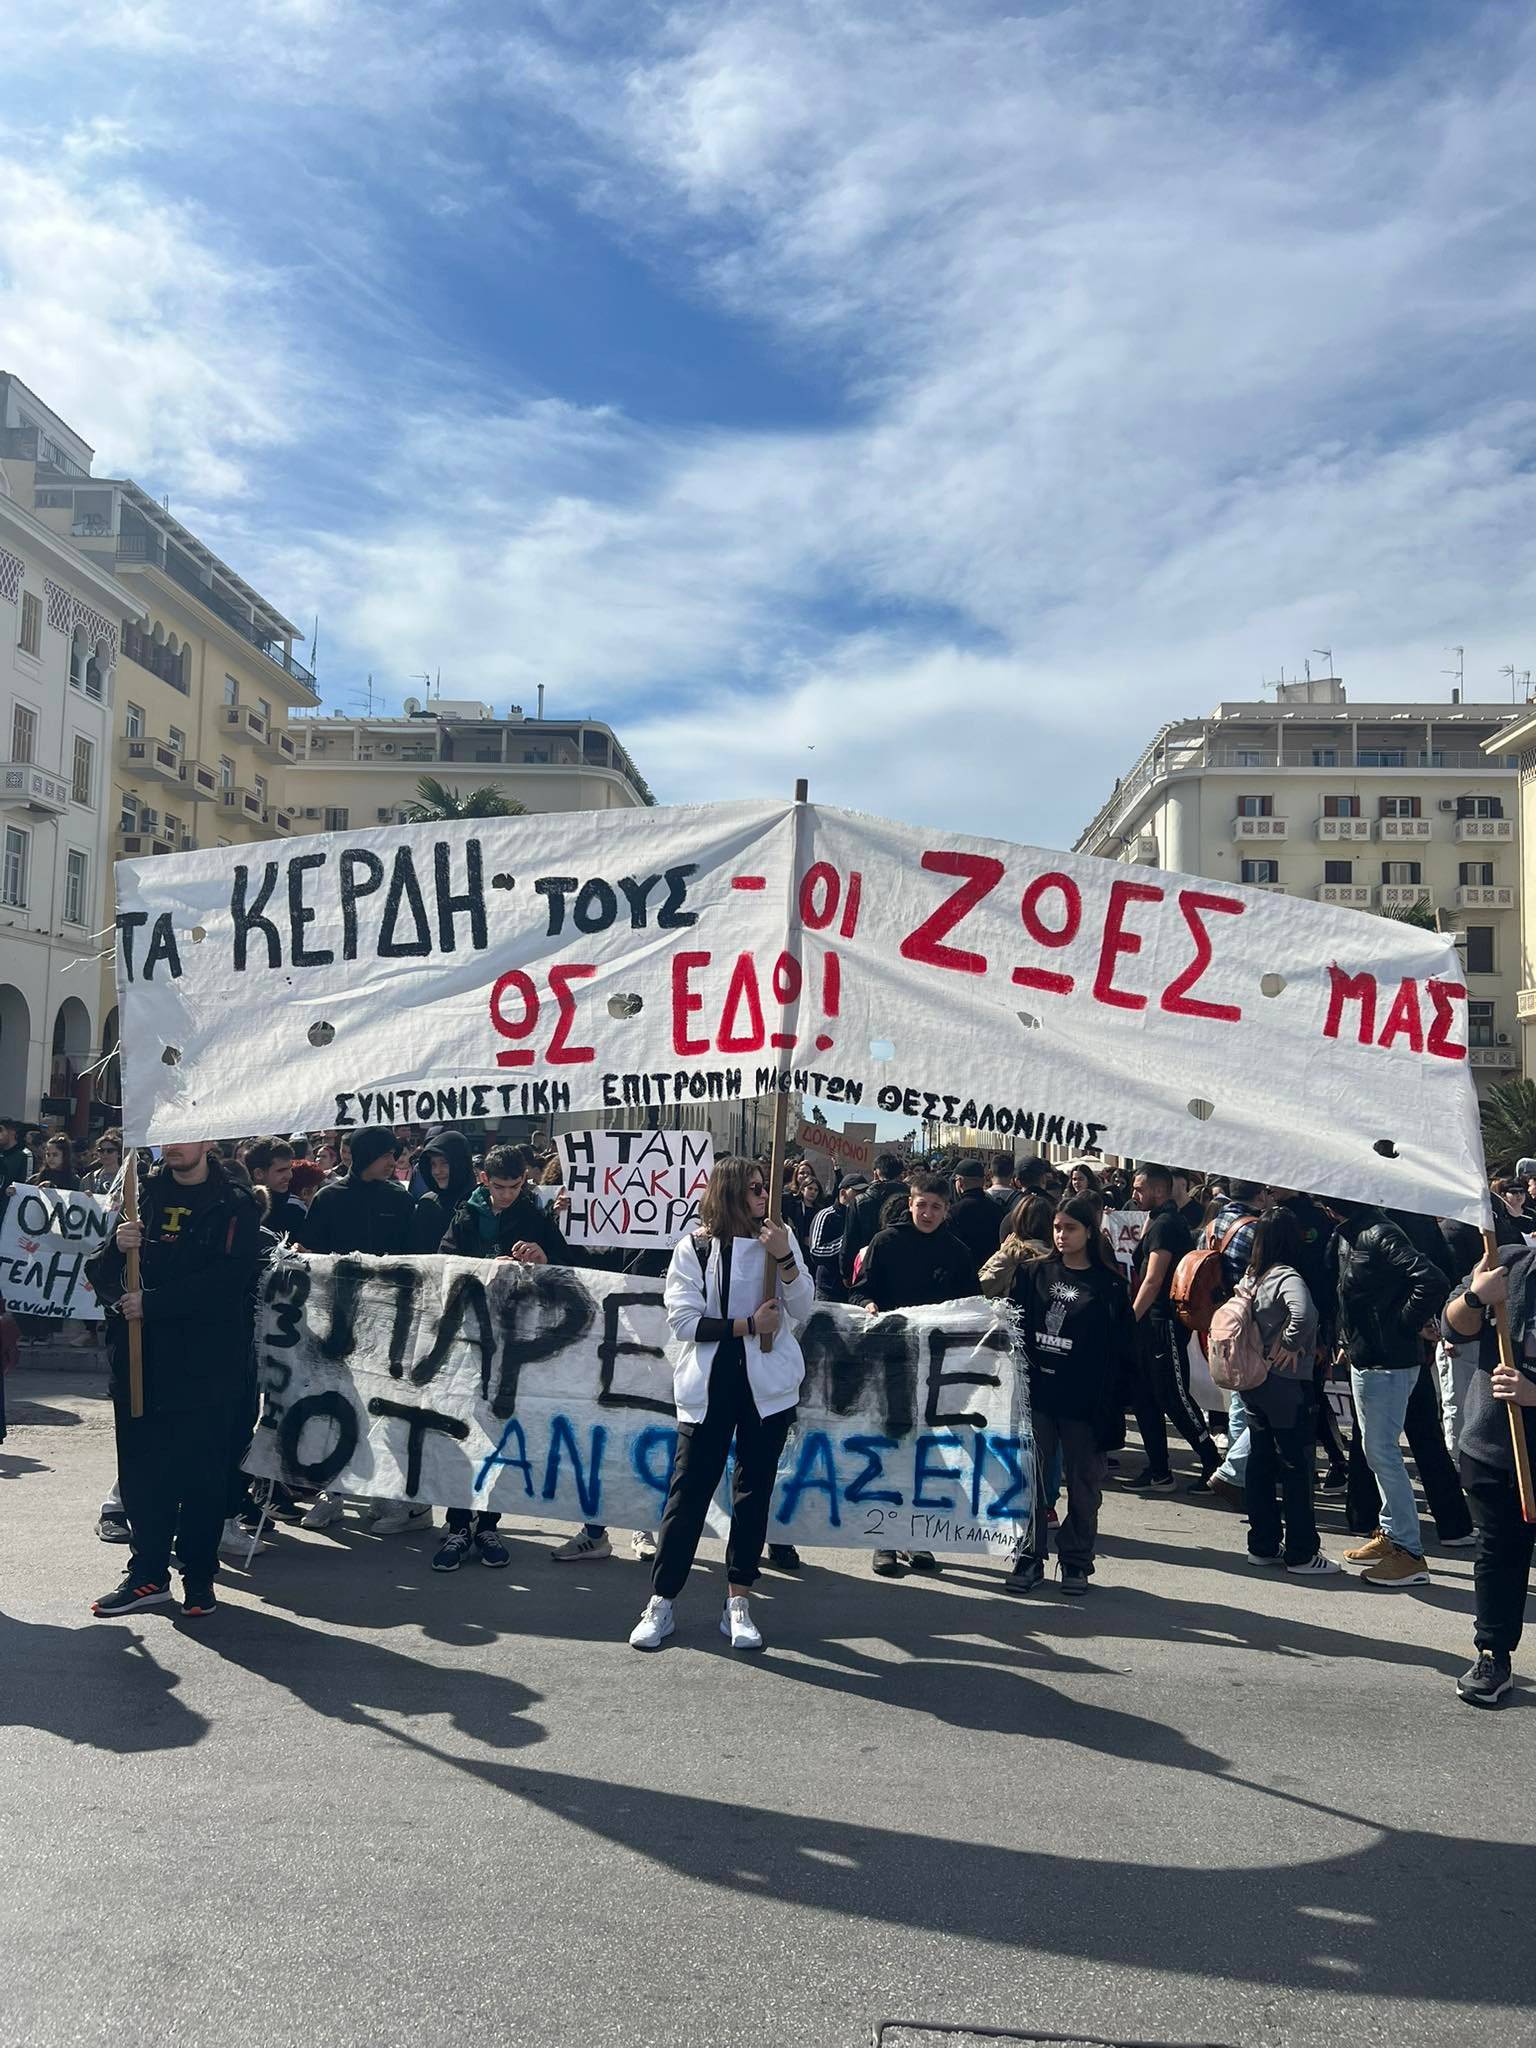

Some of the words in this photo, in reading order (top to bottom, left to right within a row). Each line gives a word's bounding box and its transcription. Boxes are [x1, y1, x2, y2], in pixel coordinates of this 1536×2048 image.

[116, 911, 183, 982] ΤΑ
[231, 838, 488, 972] ΚΕΡΔΗ
[535, 863, 699, 938] ΤΟΥΣ
[801, 861, 861, 940] ΟΙ
[900, 850, 1245, 1023] ΖΩΕΣ
[1323, 960, 1468, 1061] ΜΑΣ
[602, 1067, 742, 1107] ΕΠΙΤΡΟΠΗ
[877, 1085, 1107, 1153] ΘΕΣΣΑΛΟΝΙΚΗΣ
[604, 1166, 709, 1199] ΚΑΚΙΑ
[630, 1422, 1031, 1530] ΦΑΣΕΙΣ
